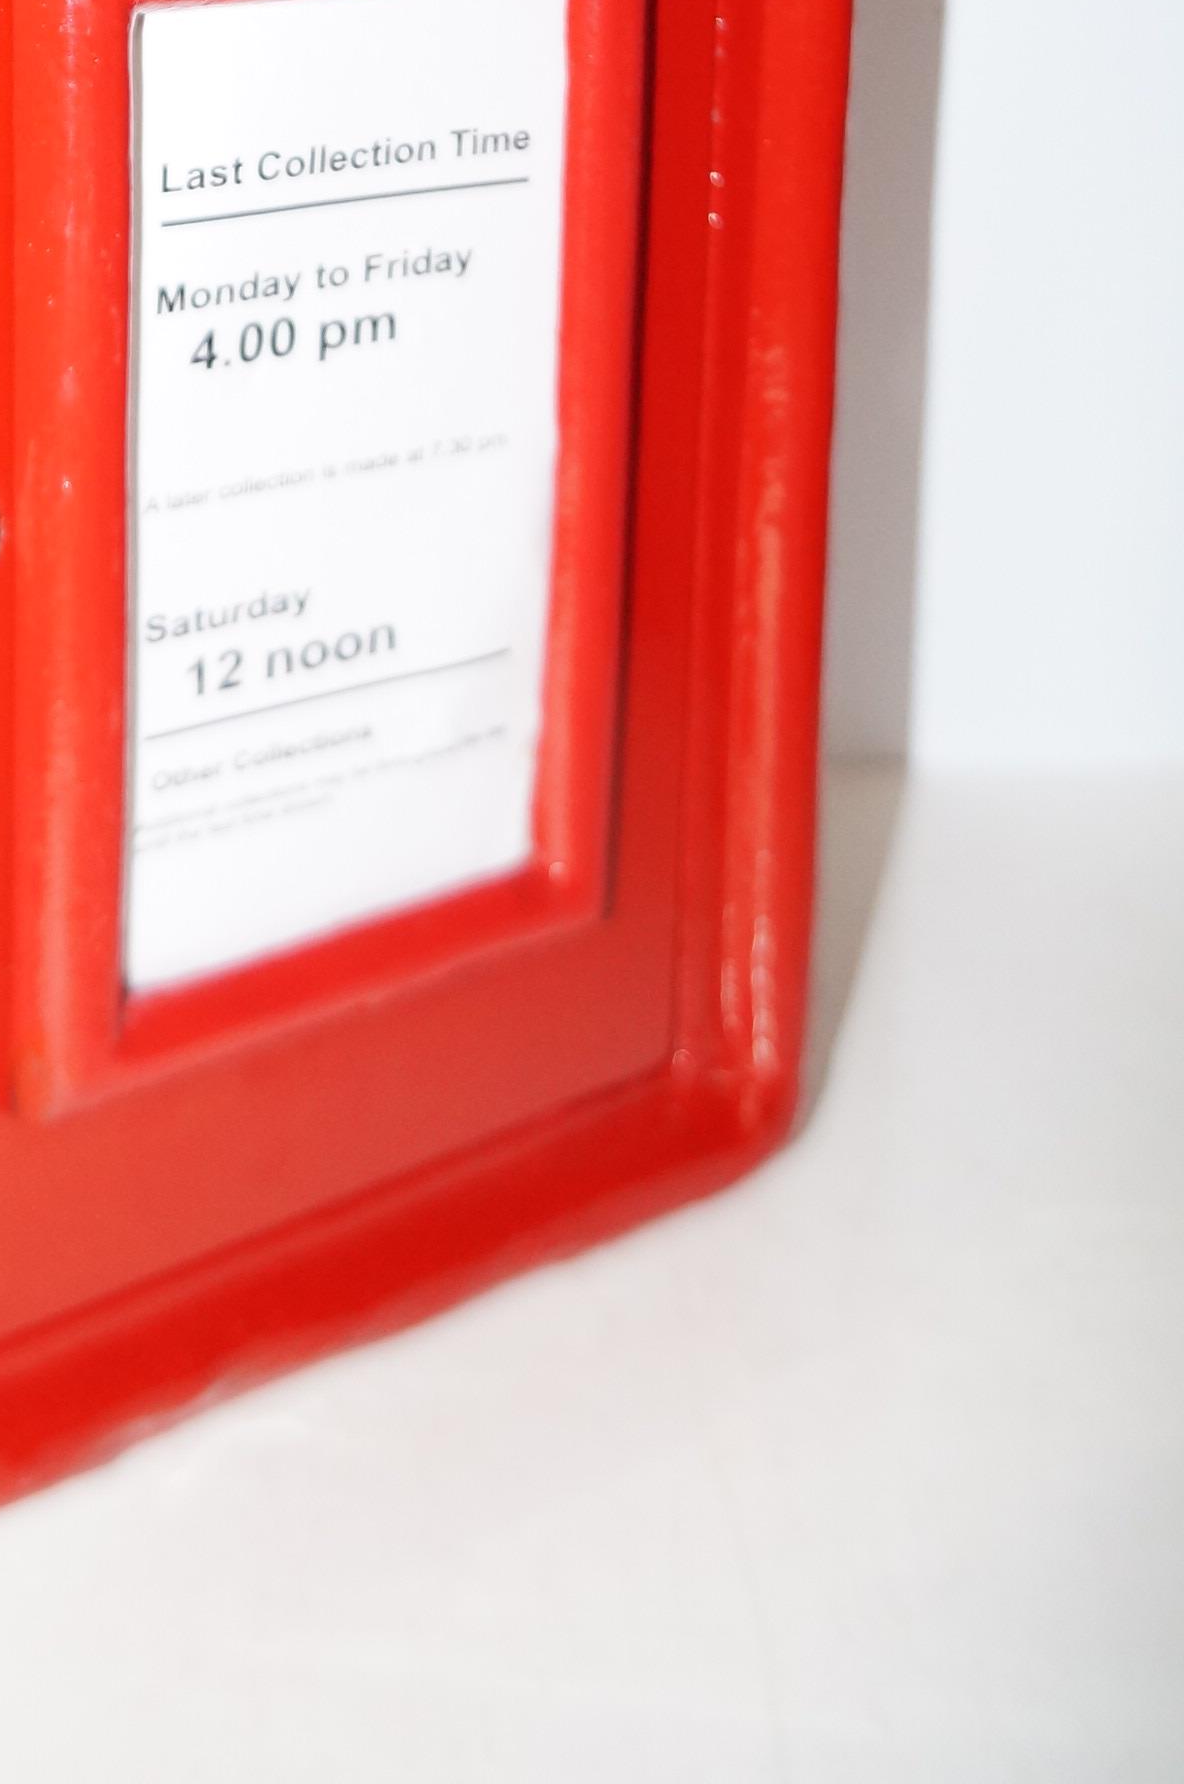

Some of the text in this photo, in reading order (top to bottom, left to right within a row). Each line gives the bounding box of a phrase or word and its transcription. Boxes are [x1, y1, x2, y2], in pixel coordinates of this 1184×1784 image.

[160, 127, 532, 193] Last Collection Time
[156, 246, 472, 315] Monday to Friday
[189, 310, 398, 371] 4.00 pm
[218, 466, 315, 500] collection
[146, 587, 312, 643] Saturday
[186, 622, 398, 696] 12 noon
[231, 723, 374, 772] Collections
